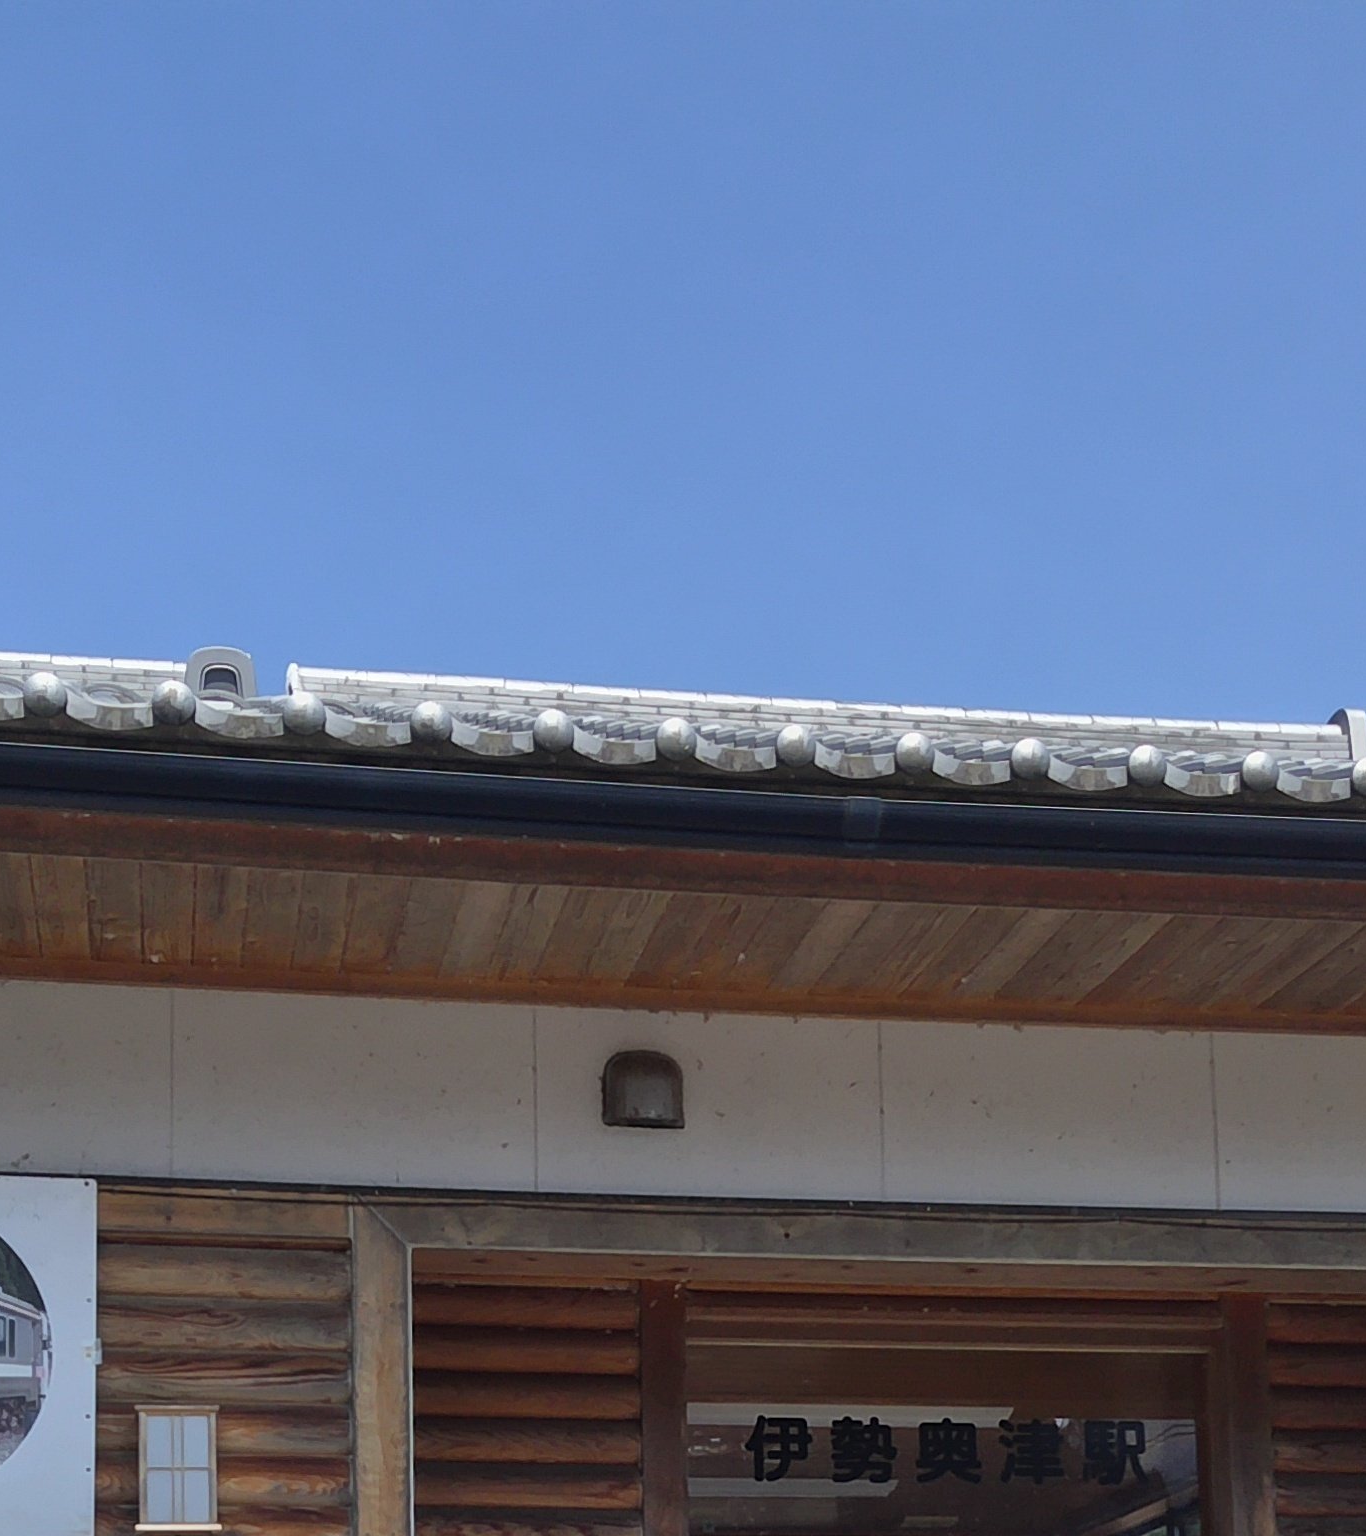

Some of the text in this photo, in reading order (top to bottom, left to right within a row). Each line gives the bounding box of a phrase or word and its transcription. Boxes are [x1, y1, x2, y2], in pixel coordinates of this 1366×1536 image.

[745, 1414, 1147, 1486] 伊勢奥津駅
